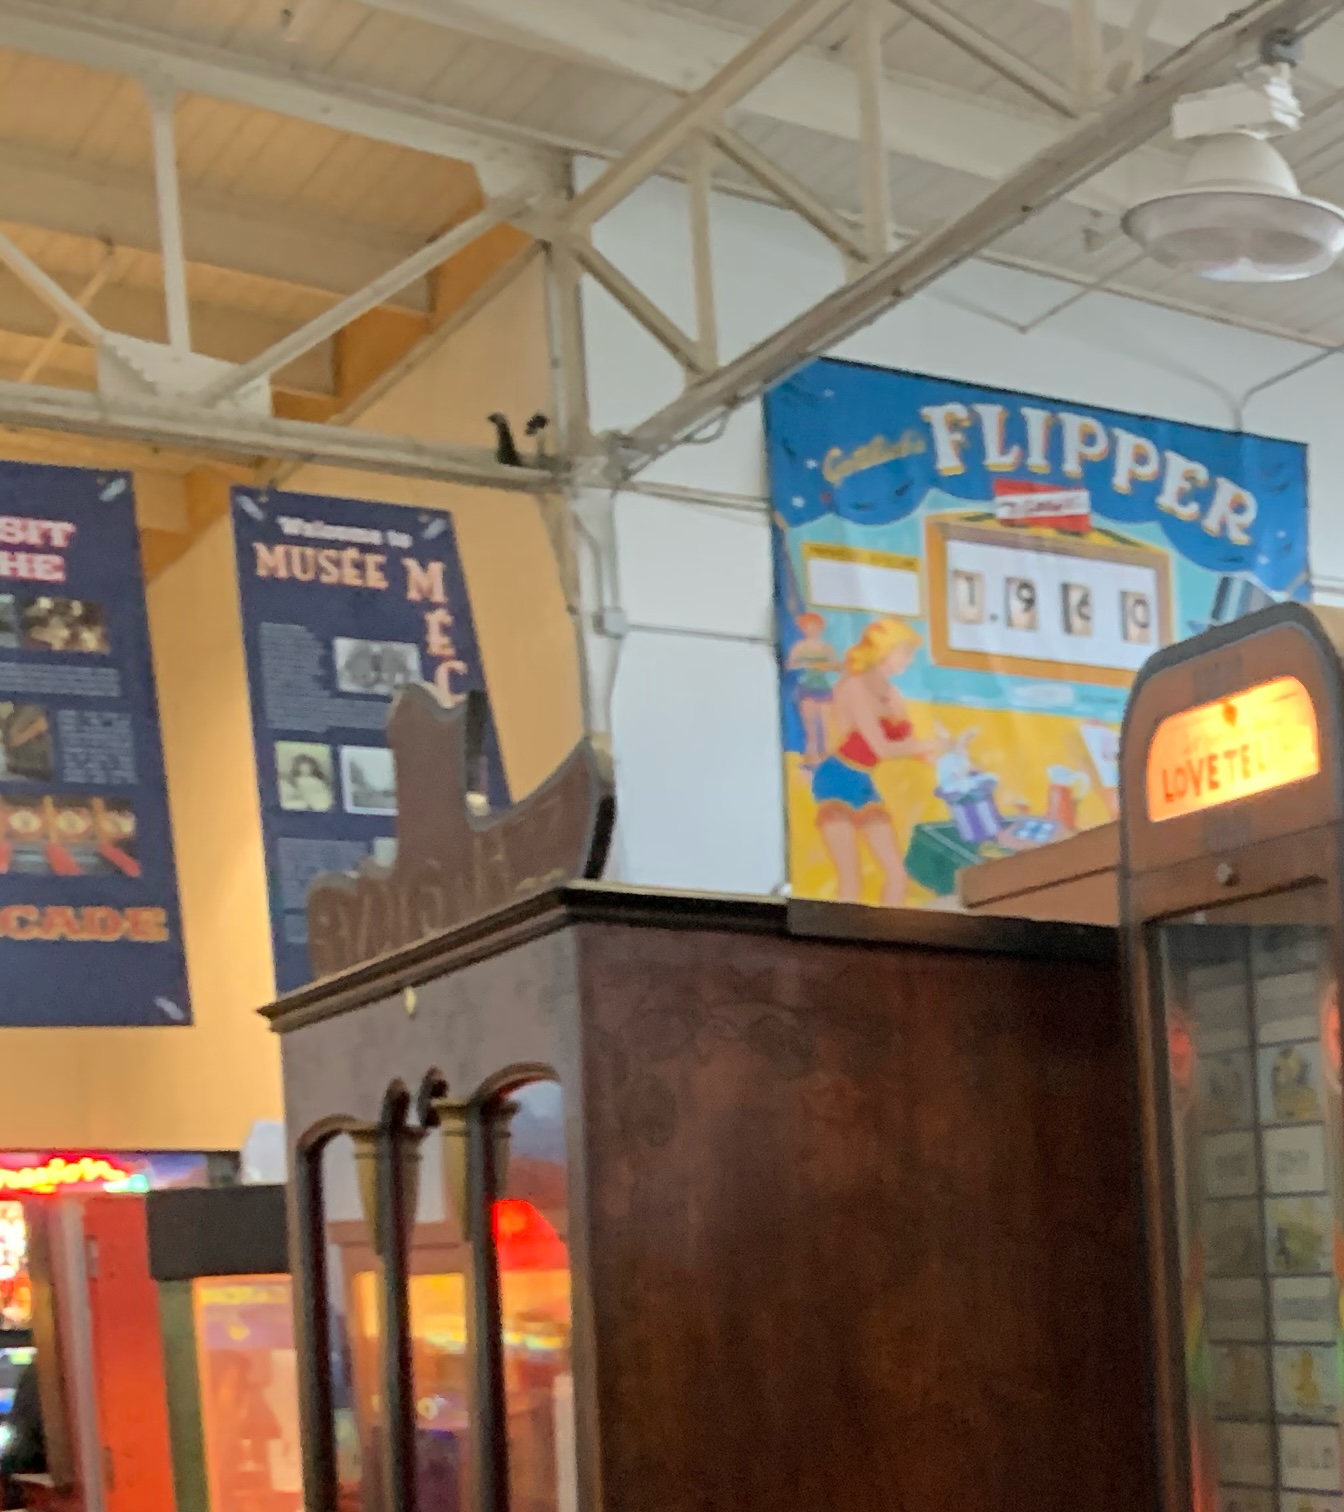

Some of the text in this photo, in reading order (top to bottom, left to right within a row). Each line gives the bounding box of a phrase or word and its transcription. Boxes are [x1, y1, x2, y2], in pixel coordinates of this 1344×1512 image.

[921, 402, 1259, 546] FLIPPER
[253, 542, 389, 591] MUSÉE
[1162, 752, 1220, 804] LOVE
